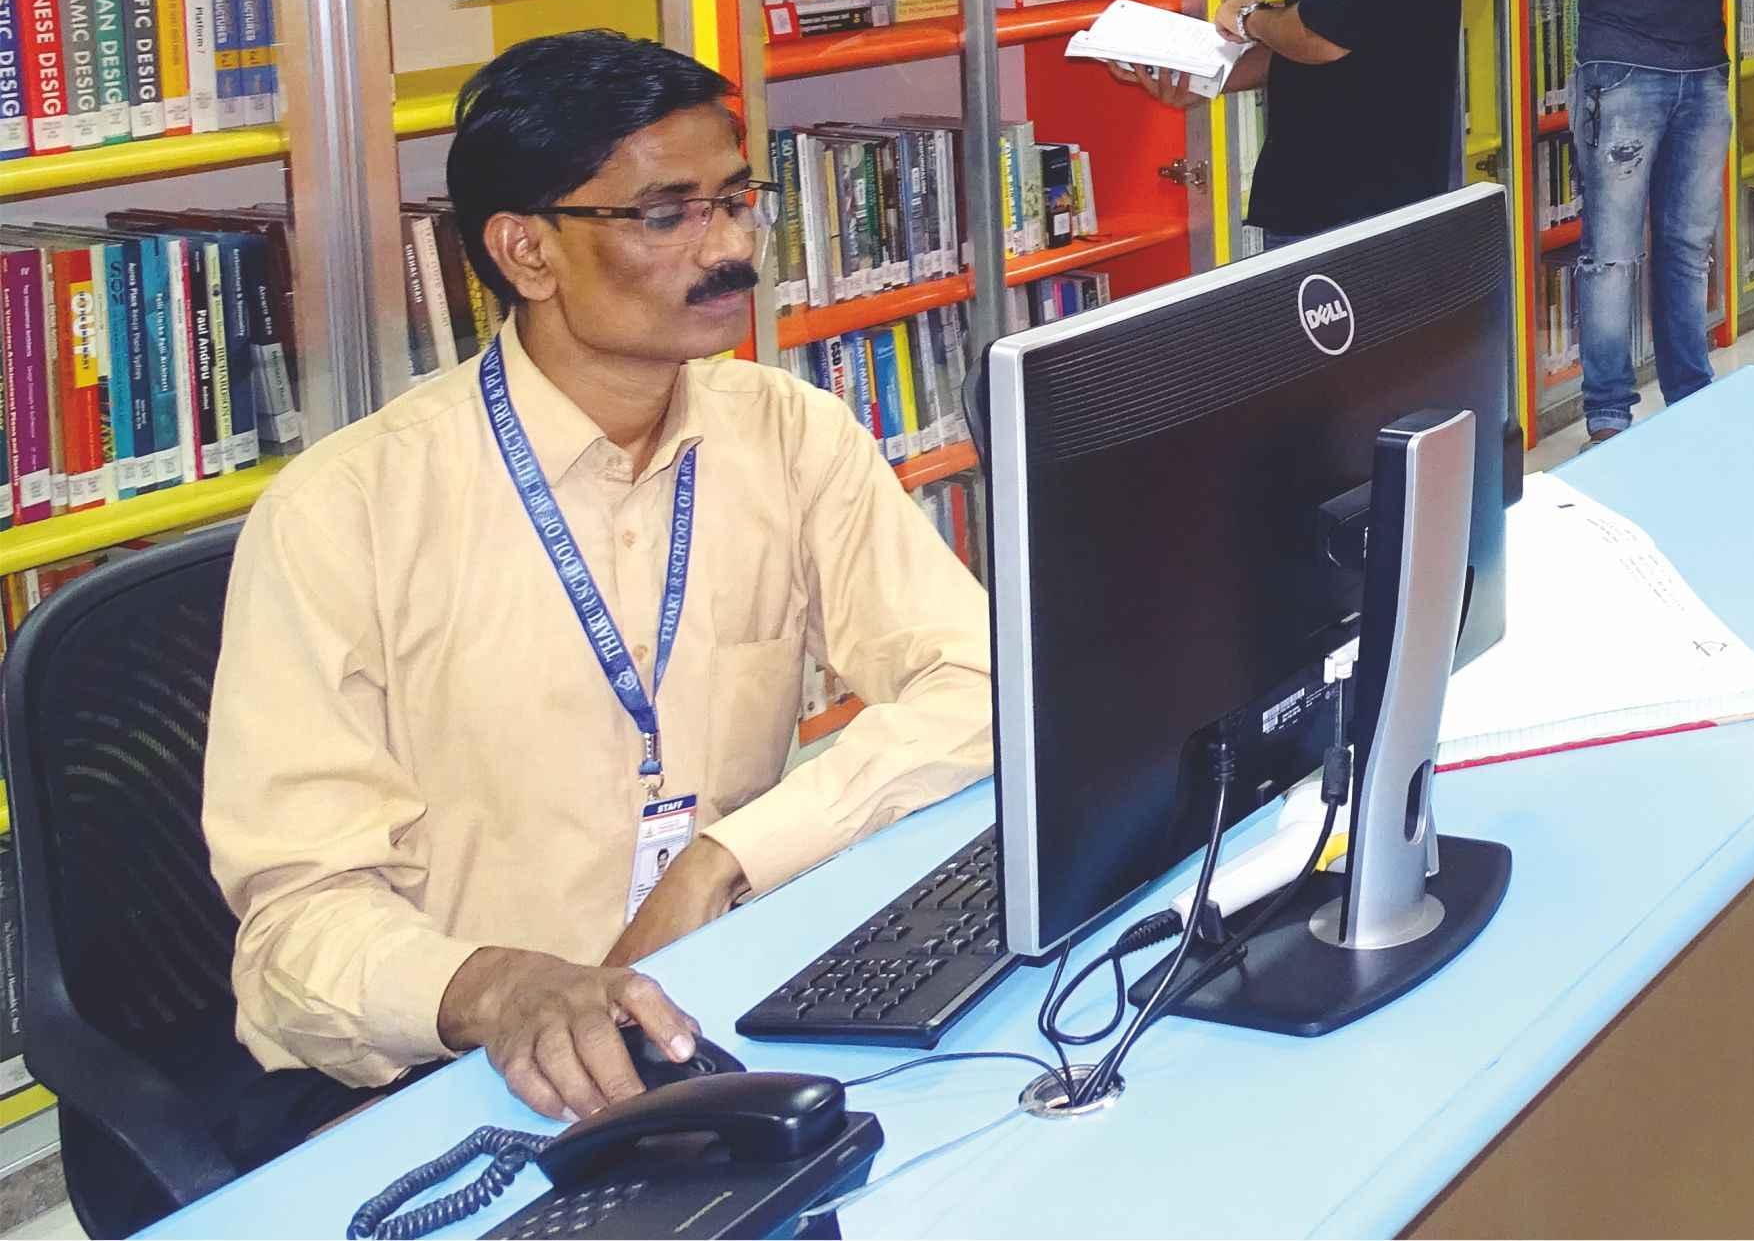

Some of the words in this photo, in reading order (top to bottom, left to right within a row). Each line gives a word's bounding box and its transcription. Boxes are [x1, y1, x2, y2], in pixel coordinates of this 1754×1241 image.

[194, 7, 206, 47] Platform
[0, 51, 20, 117] DESIG
[38, 52, 61, 114] DESIG
[73, 50, 95, 111] DESIG
[100, 40, 122, 104] DESIG
[136, 38, 156, 100] DESIG
[129, 287, 139, 307] Place
[197, 309, 208, 336] Paul
[1305, 299, 1347, 330] DELL
[199, 338, 211, 380] Andreu
[216, 347, 230, 417] RICHARDSON
[490, 385, 505, 401] &
[491, 397, 554, 515] ARCHITECTURE
[543, 516, 564, 538] OF
[677, 488, 693, 508] OF
[553, 534, 594, 601] SCHOOL
[671, 510, 690, 575] SCHOOL
[582, 598, 624, 663] THAKUR
[660, 577, 684, 643] THAKUR
[657, 799, 684, 814] STAFF
